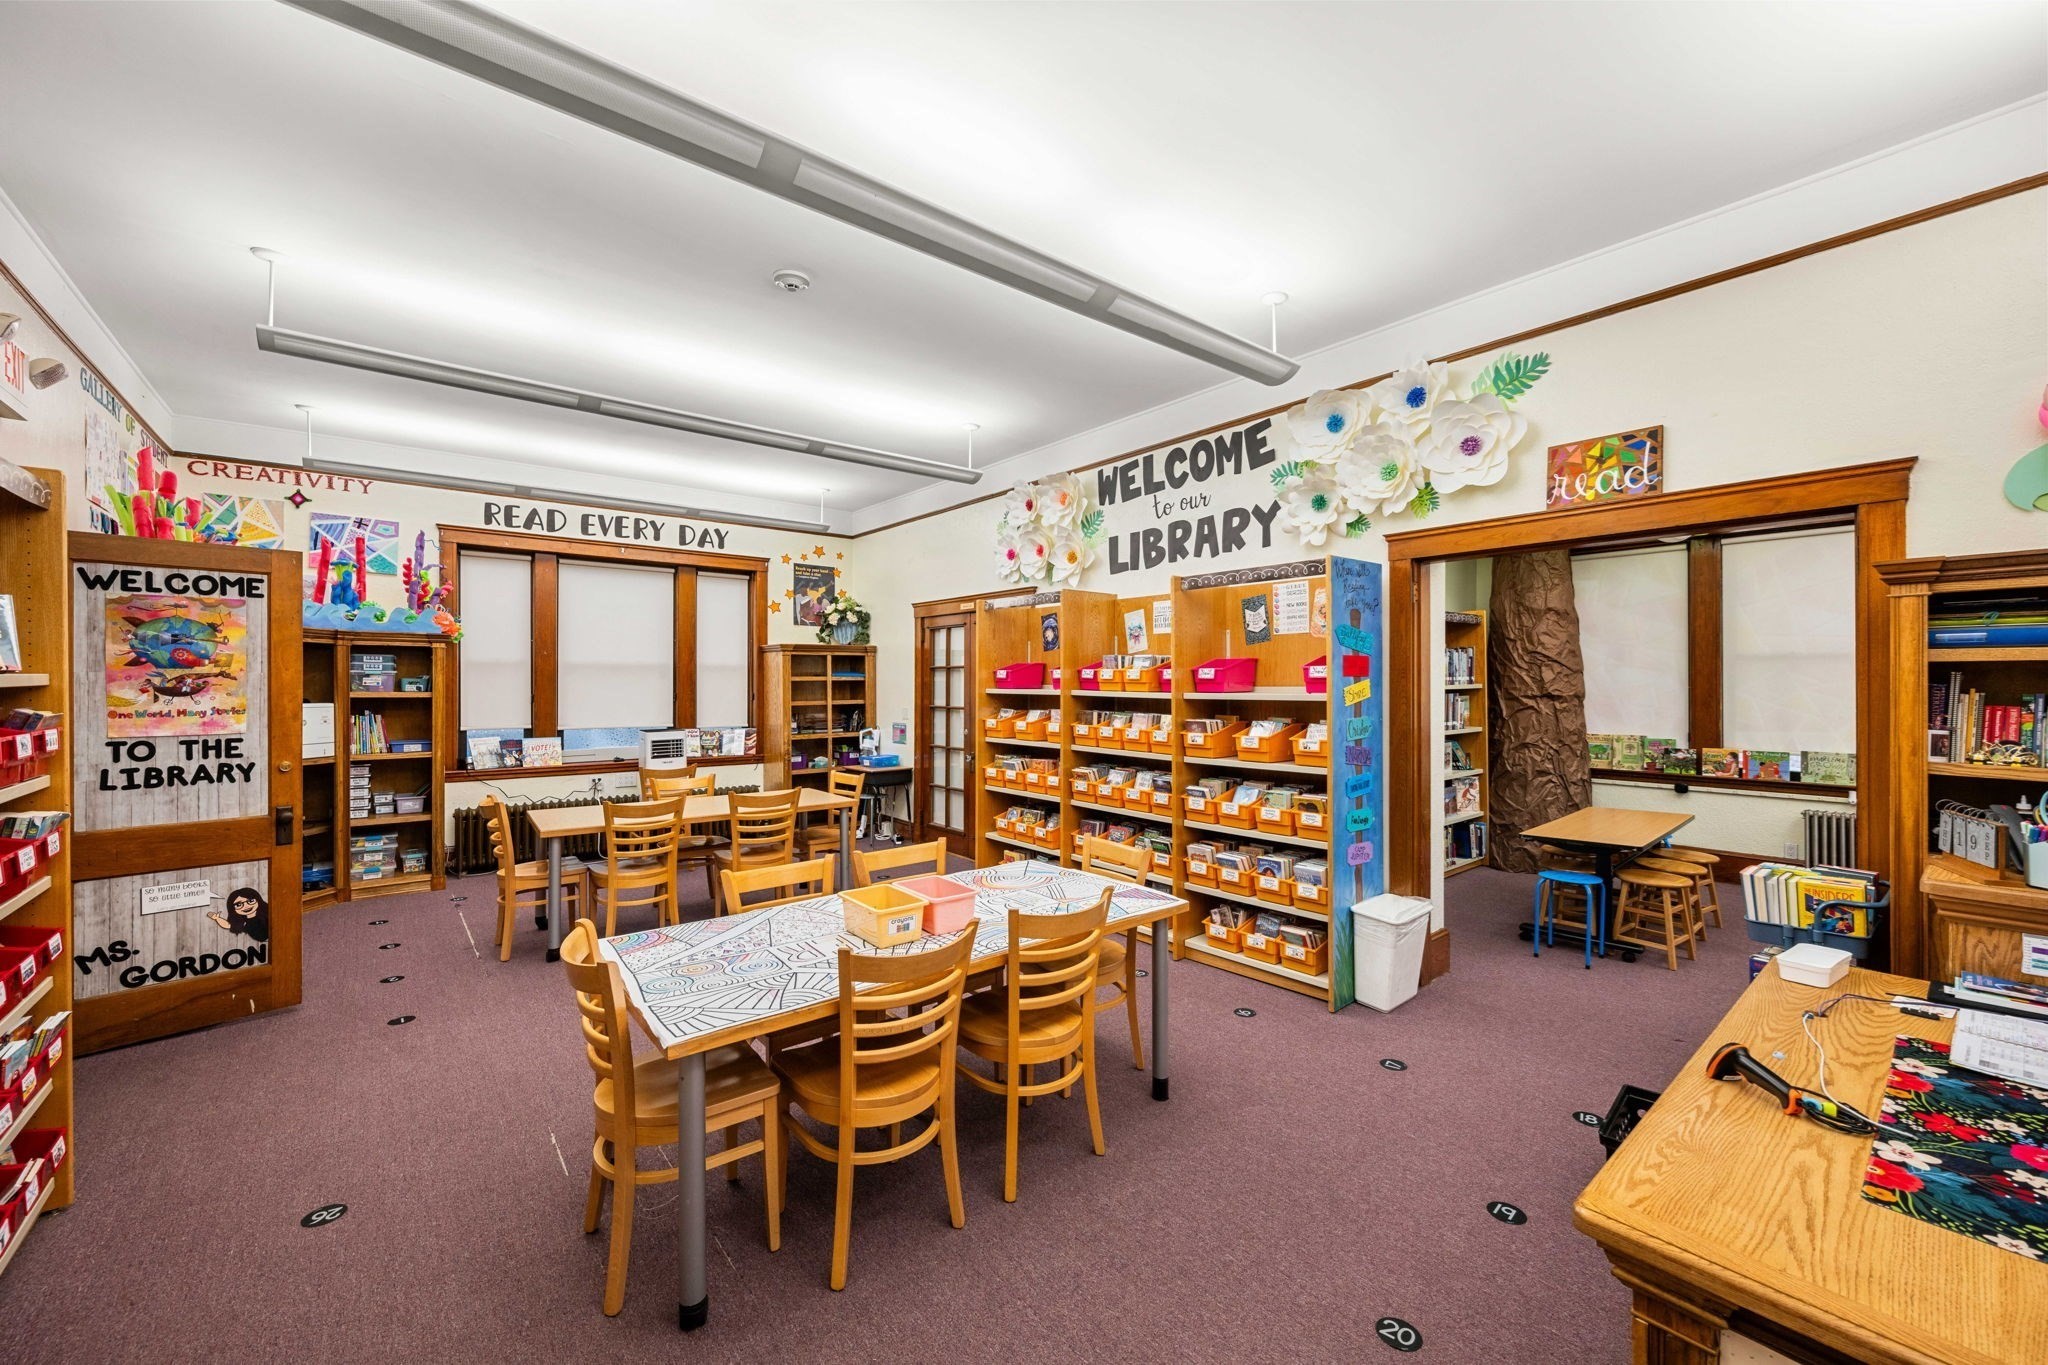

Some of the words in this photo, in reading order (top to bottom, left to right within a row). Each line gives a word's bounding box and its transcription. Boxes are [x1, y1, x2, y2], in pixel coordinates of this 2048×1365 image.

[5, 341, 26, 394] EXIT
[80, 367, 122, 422] GALLERY
[125, 413, 136, 436] OF
[187, 460, 374, 494] CREATIVITY
[1098, 418, 1276, 506] WELCOME
[1547, 441, 1662, 504] read
[1153, 494, 1175, 519] to
[1180, 493, 1212, 511] our
[484, 502, 567, 533] READ
[581, 513, 665, 542] EVERY
[679, 524, 729, 550] DAY
[1108, 499, 1282, 575] LIBRARY
[76, 566, 265, 599] WELCOME
[107, 709, 134, 720] One
[134, 708, 175, 719] World,
[176, 708, 207, 718] Many
[210, 706, 246, 716] Stories
[105, 740, 156, 763] TO
[179, 737, 244, 761] THE
[99, 762, 256, 791] LIBRARY
[158, 884, 181, 893] many
[891, 915, 914, 925] crayons
[74, 940, 140, 975] MS.
[120, 944, 266, 988] GORDON
[1580, 1113, 1598, 1124] 18
[309, 1206, 344, 1226] 26
[1493, 1202, 1517, 1221] 19
[1379, 1319, 1416, 1346] 20
